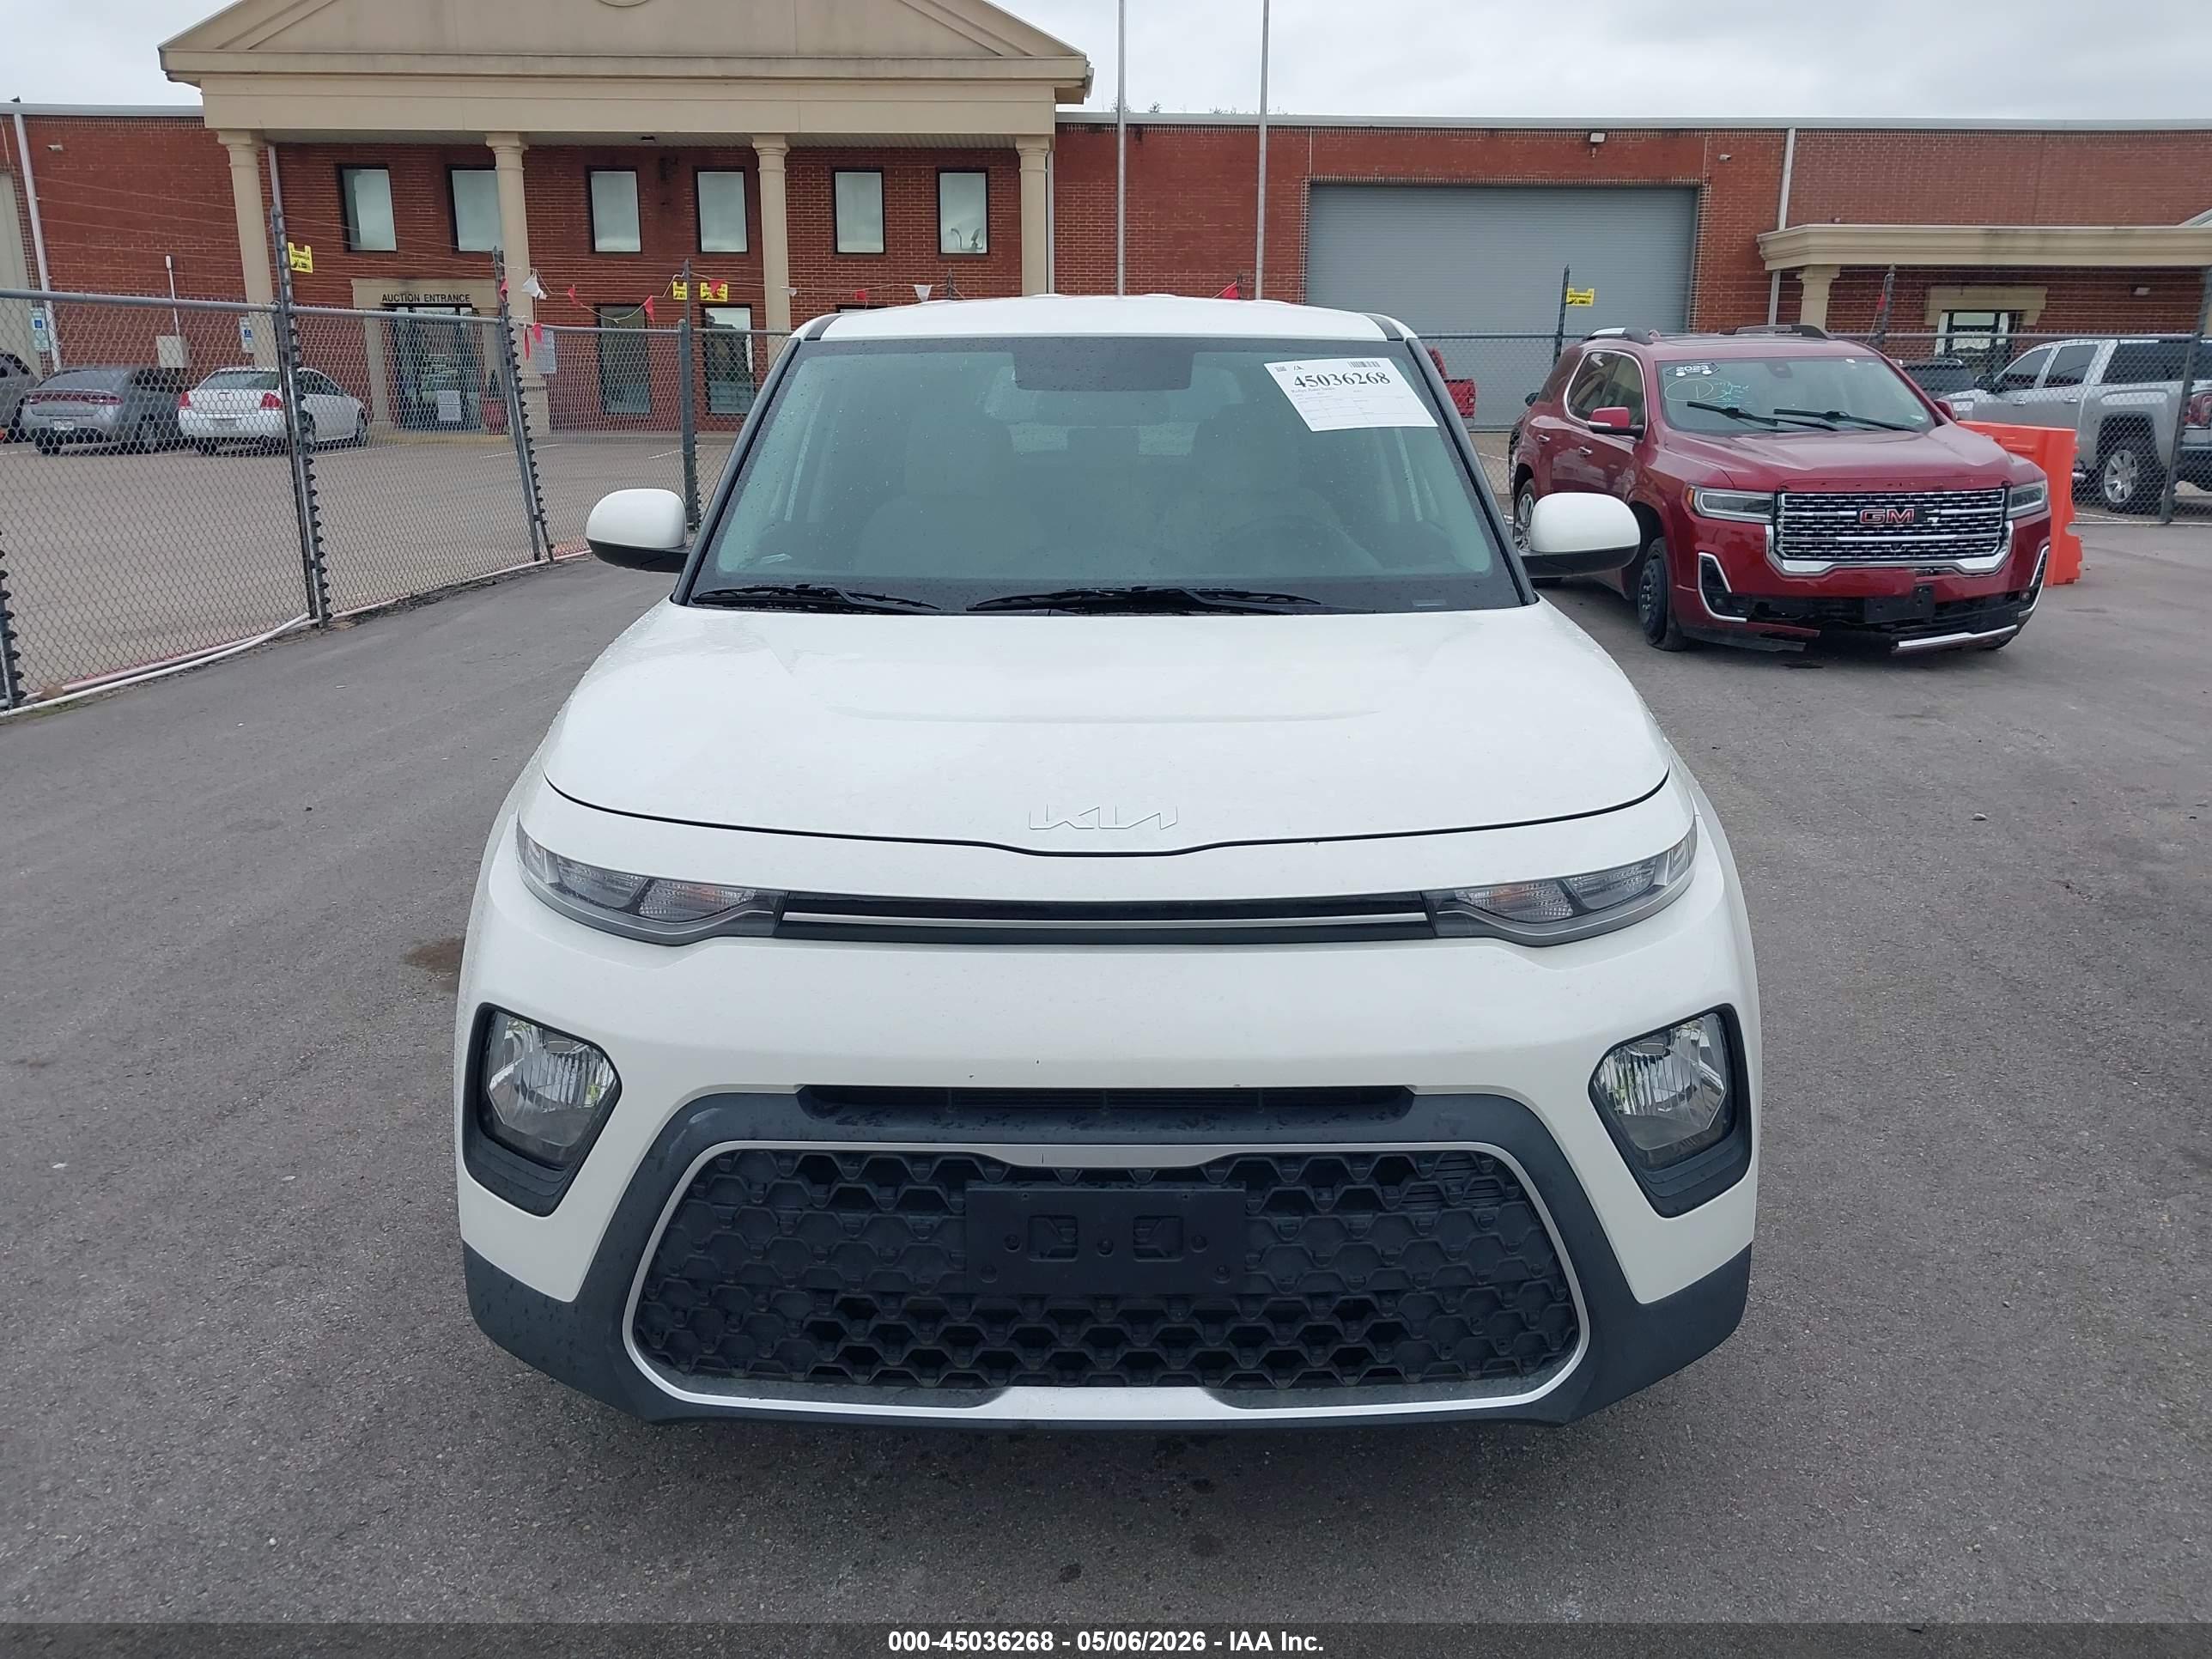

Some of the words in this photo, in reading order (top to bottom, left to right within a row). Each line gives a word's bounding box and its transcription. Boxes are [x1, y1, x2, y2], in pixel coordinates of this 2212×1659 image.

[381, 294, 420, 302] AUCTION
[423, 294, 471, 302] ENTRANCE
[1294, 371, 1391, 388] 45036268
